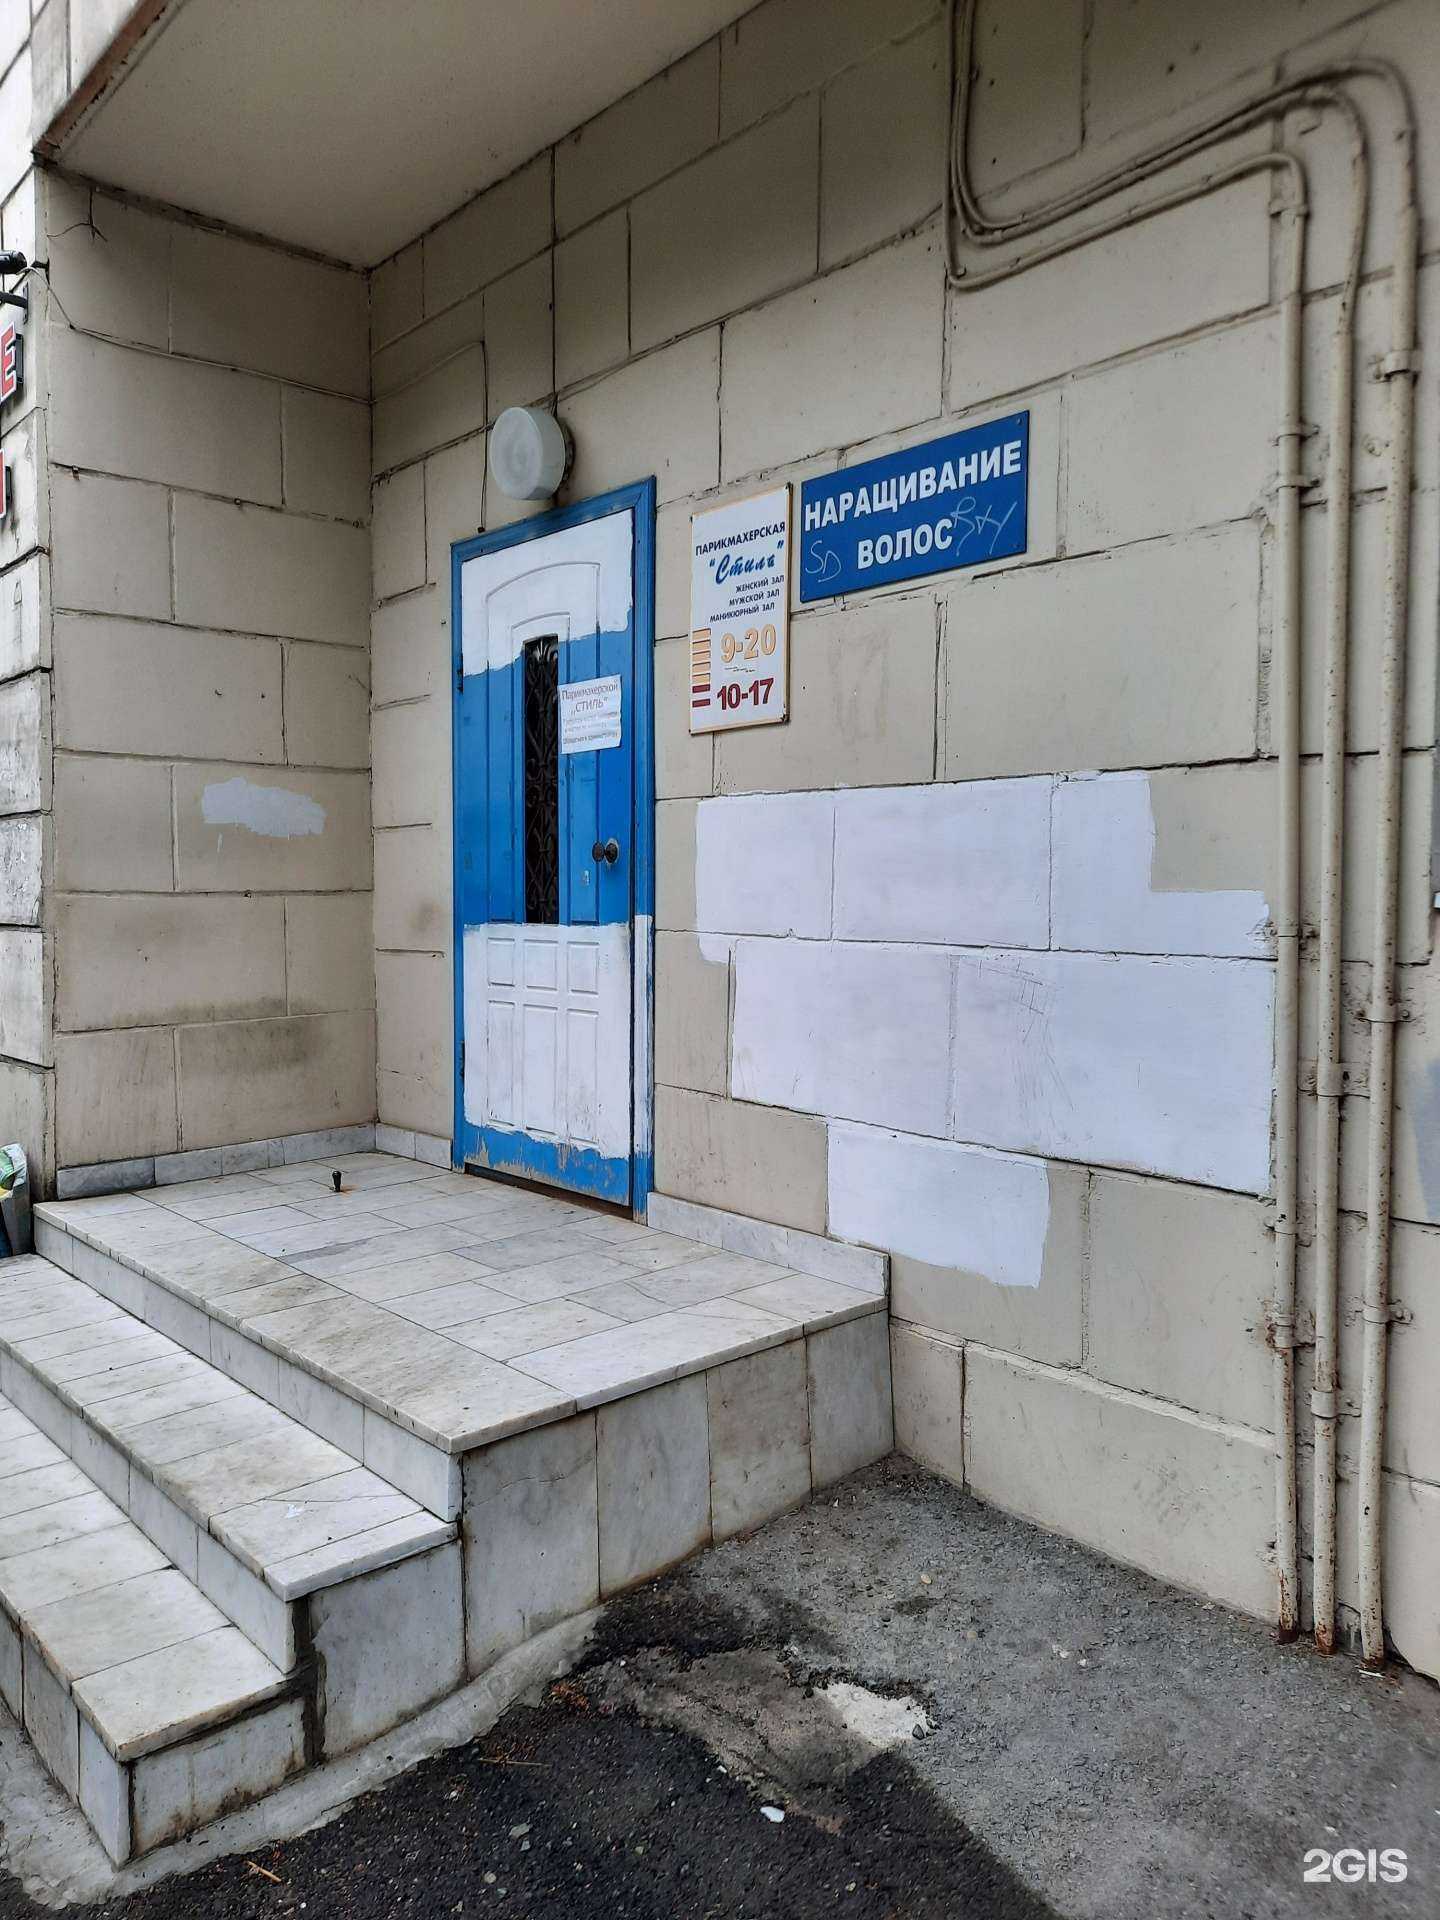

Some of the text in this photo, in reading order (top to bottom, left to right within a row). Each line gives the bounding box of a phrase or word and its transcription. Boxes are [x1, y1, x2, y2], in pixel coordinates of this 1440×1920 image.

[804, 440, 1022, 531] НАРАЩИВАНИЕ
[695, 521, 786, 556] ПАРИКМАХЕРСКАЯ
[857, 518, 953, 570] ВОЛОС
[729, 589, 780, 607] МУЖСКОЙ ЗАЛ
[735, 575, 785, 593] ЖЕНСКИЙ ЗАЛ
[709, 602, 775, 623] МАНИКЮРНЫЙ ЗАЛ
[721, 624, 777, 663] 9-20
[717, 677, 774, 711] 10-17
